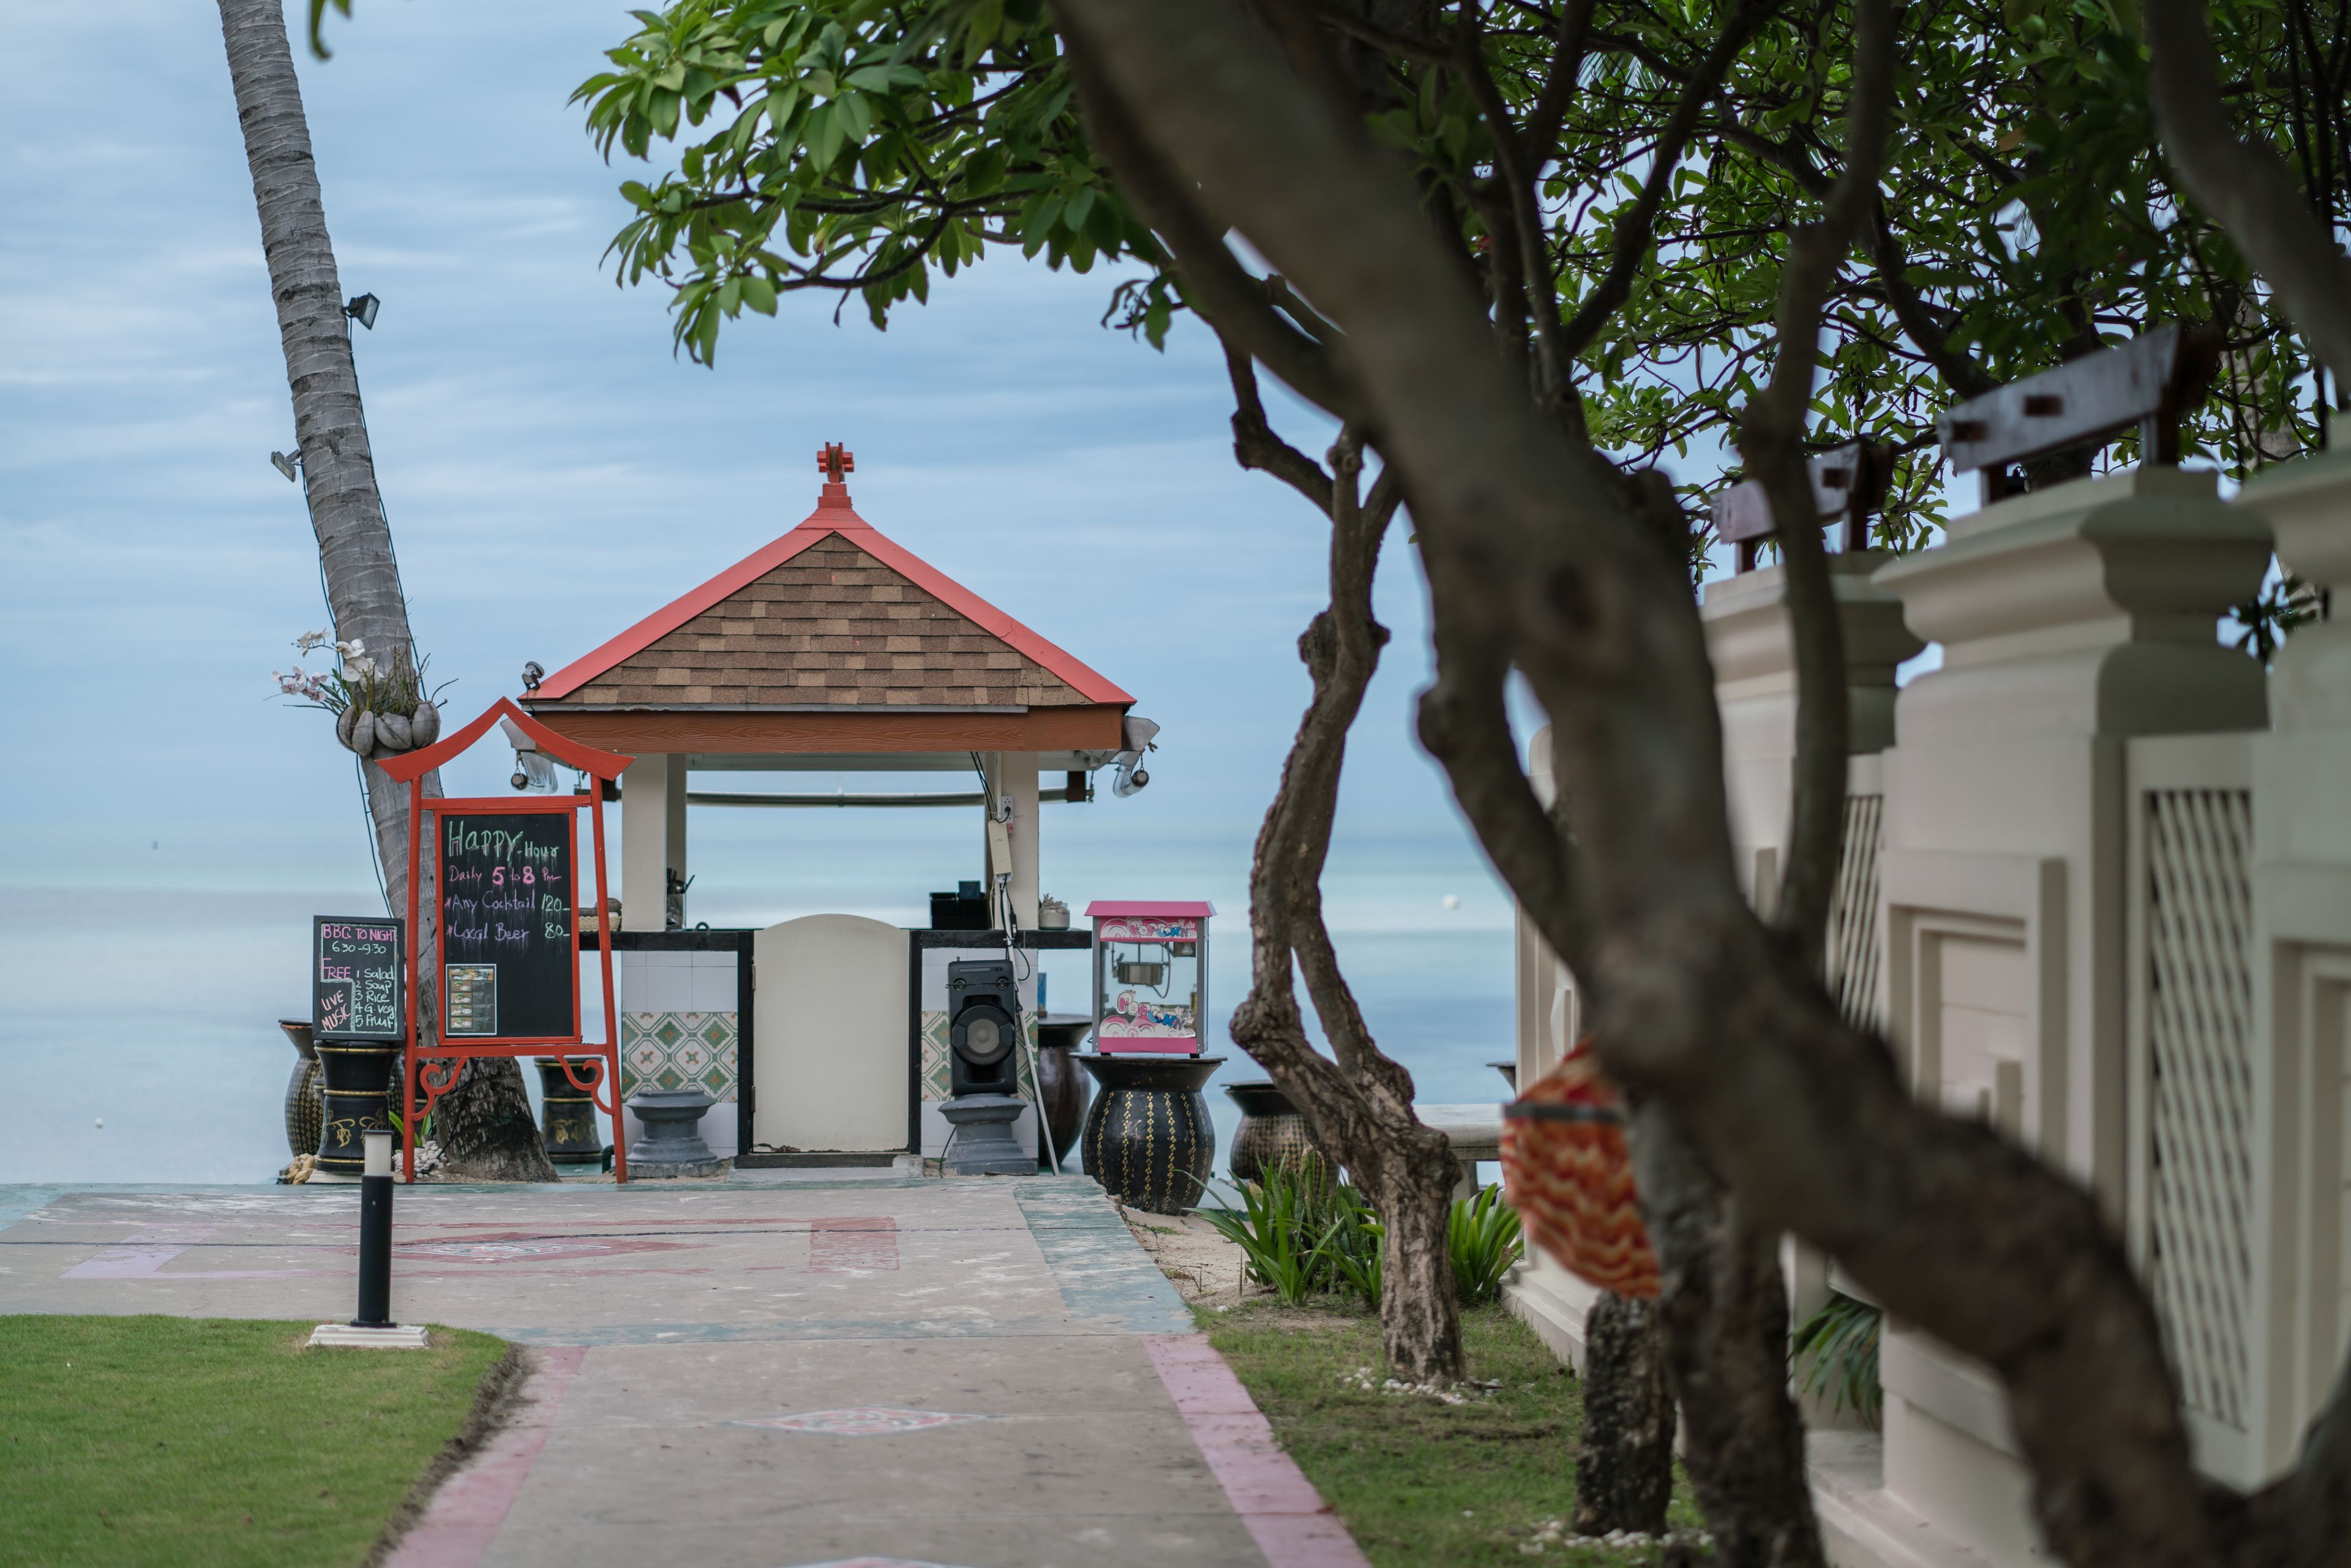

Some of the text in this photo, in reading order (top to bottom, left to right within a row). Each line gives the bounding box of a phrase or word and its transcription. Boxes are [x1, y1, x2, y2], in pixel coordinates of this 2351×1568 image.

[525, 841, 560, 858] Hour
[449, 865, 482, 882] Daily
[492, 866, 506, 885] 5
[510, 868, 520, 881] to
[523, 866, 536, 884] 8
[452, 894, 478, 914] Any
[482, 889, 535, 910] Cocktail
[323, 925, 351, 939] BBQ
[454, 920, 489, 940] Local
[495, 922, 530, 941] Beer
[1128, 919, 1191, 937] POPCORN
[322, 958, 351, 980] FREE
[364, 965, 394, 980] Salad
[366, 980, 392, 994] Soup
[355, 991, 390, 1003] 3 Rice
[354, 1002, 364, 1013] 4
[1117, 991, 1188, 1030] POPCORN
[321, 1003, 351, 1032] MUSIC
[355, 1014, 394, 1029] 5 Fruit
